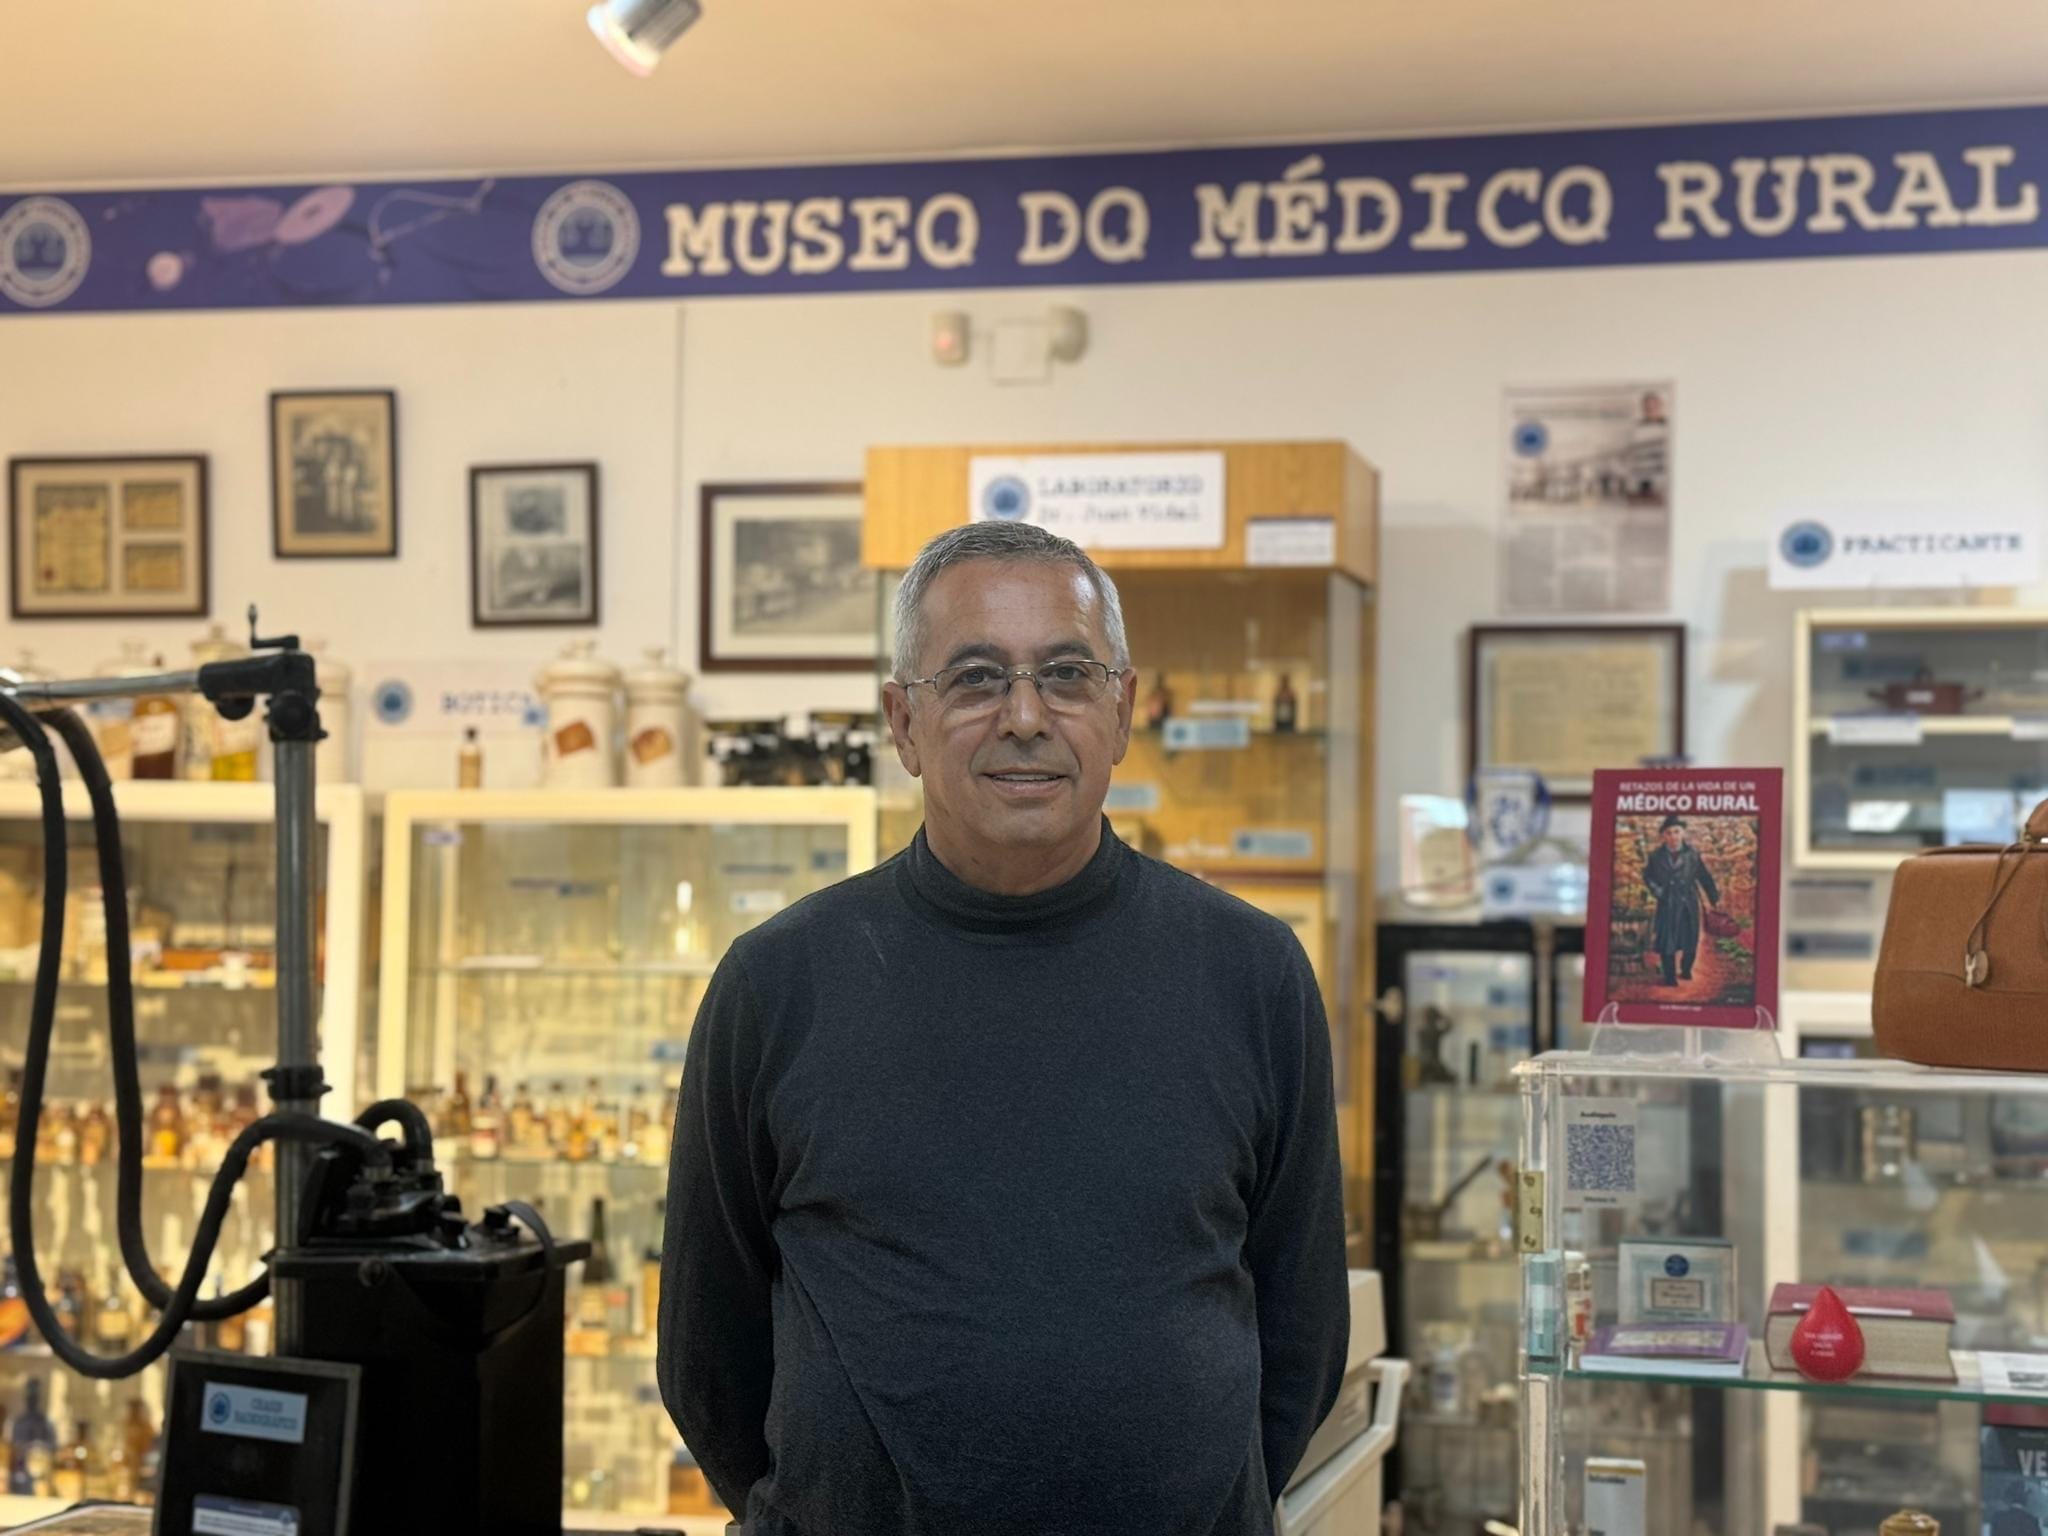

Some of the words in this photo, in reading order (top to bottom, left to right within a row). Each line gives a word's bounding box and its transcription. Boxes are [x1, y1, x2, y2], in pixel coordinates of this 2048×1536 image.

[661, 193, 979, 276] MUSEO
[1017, 187, 1150, 265] DO
[1191, 156, 1613, 258] MÉDICO
[1655, 146, 2039, 240] RURAL
[1038, 475, 1204, 497] LABORATORIO
[1843, 534, 2023, 554] PRACTICANTE
[1619, 781, 1664, 792] RETAZOS
[1665, 782, 1677, 792] DE
[1681, 781, 1694, 791] LA
[1696, 781, 1722, 791] VIDA
[1723, 781, 1738, 791] DE
[1739, 781, 1756, 791] UN
[1616, 793, 1692, 812] MÉDICO
[1696, 794, 1760, 811] RURAL
